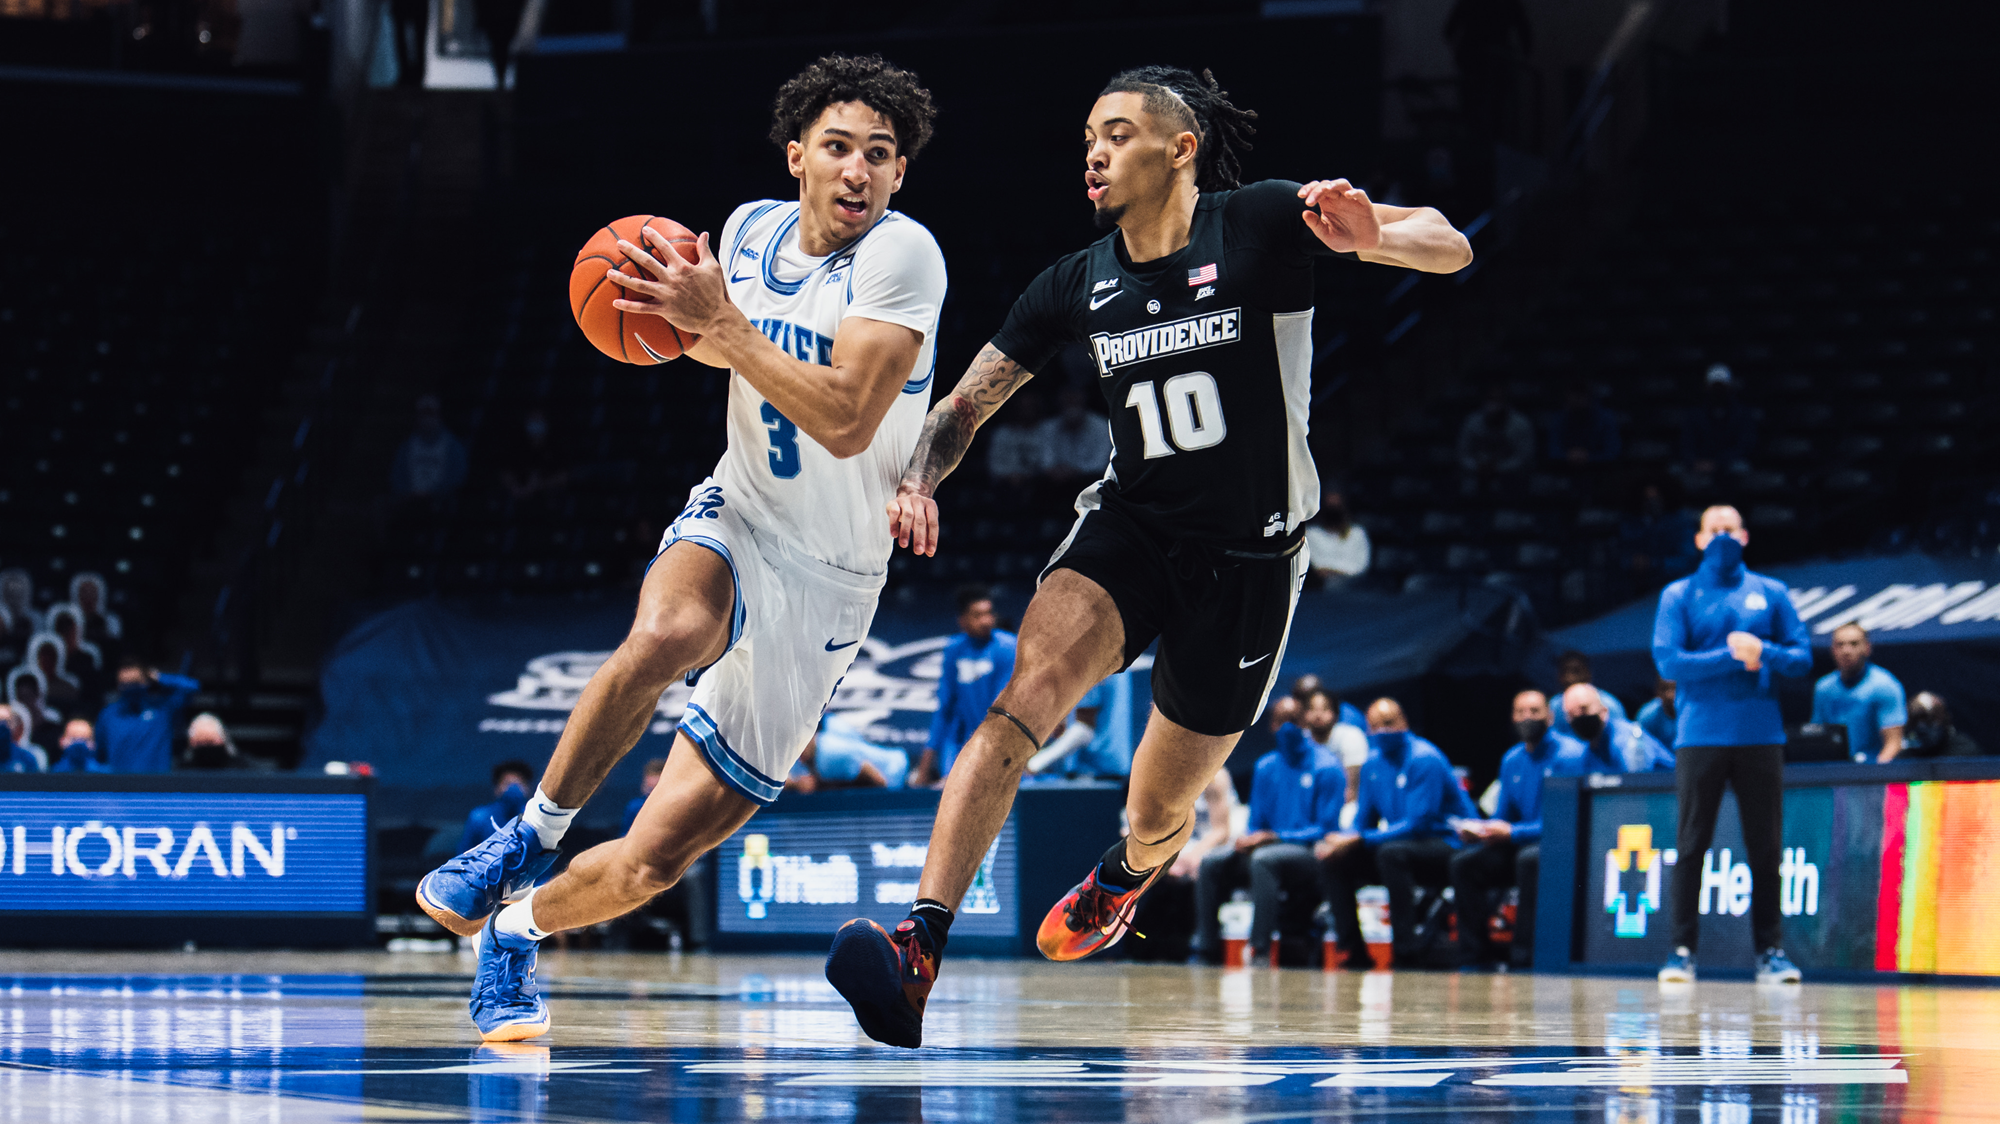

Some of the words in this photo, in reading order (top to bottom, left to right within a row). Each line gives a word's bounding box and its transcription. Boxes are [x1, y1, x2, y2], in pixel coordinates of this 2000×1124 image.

[1092, 311, 1239, 376] PROVIDENCE
[760, 399, 802, 480] 3
[1125, 371, 1227, 460] 10
[1268, 511, 1281, 523] 46
[12, 820, 286, 878] HORAN
